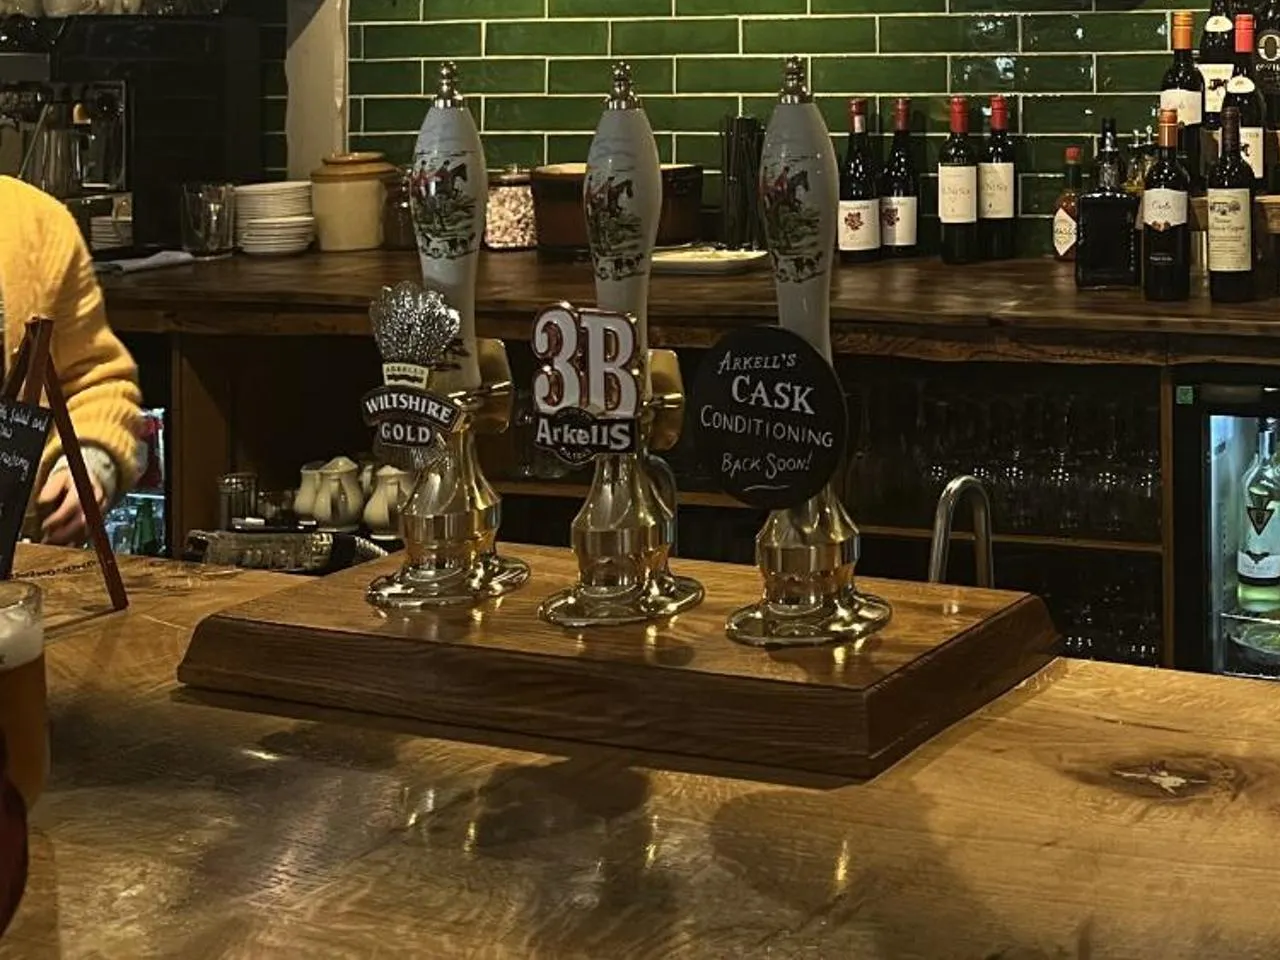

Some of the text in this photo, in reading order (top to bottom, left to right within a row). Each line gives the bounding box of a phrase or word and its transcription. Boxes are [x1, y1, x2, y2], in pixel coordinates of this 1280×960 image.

[535, 308, 638, 420] 3B
[365, 392, 454, 424] WILTSHIRE
[731, 374, 816, 415] CASK
[381, 422, 431, 443] GOLD
[700, 404, 834, 448] CONDITIONING
